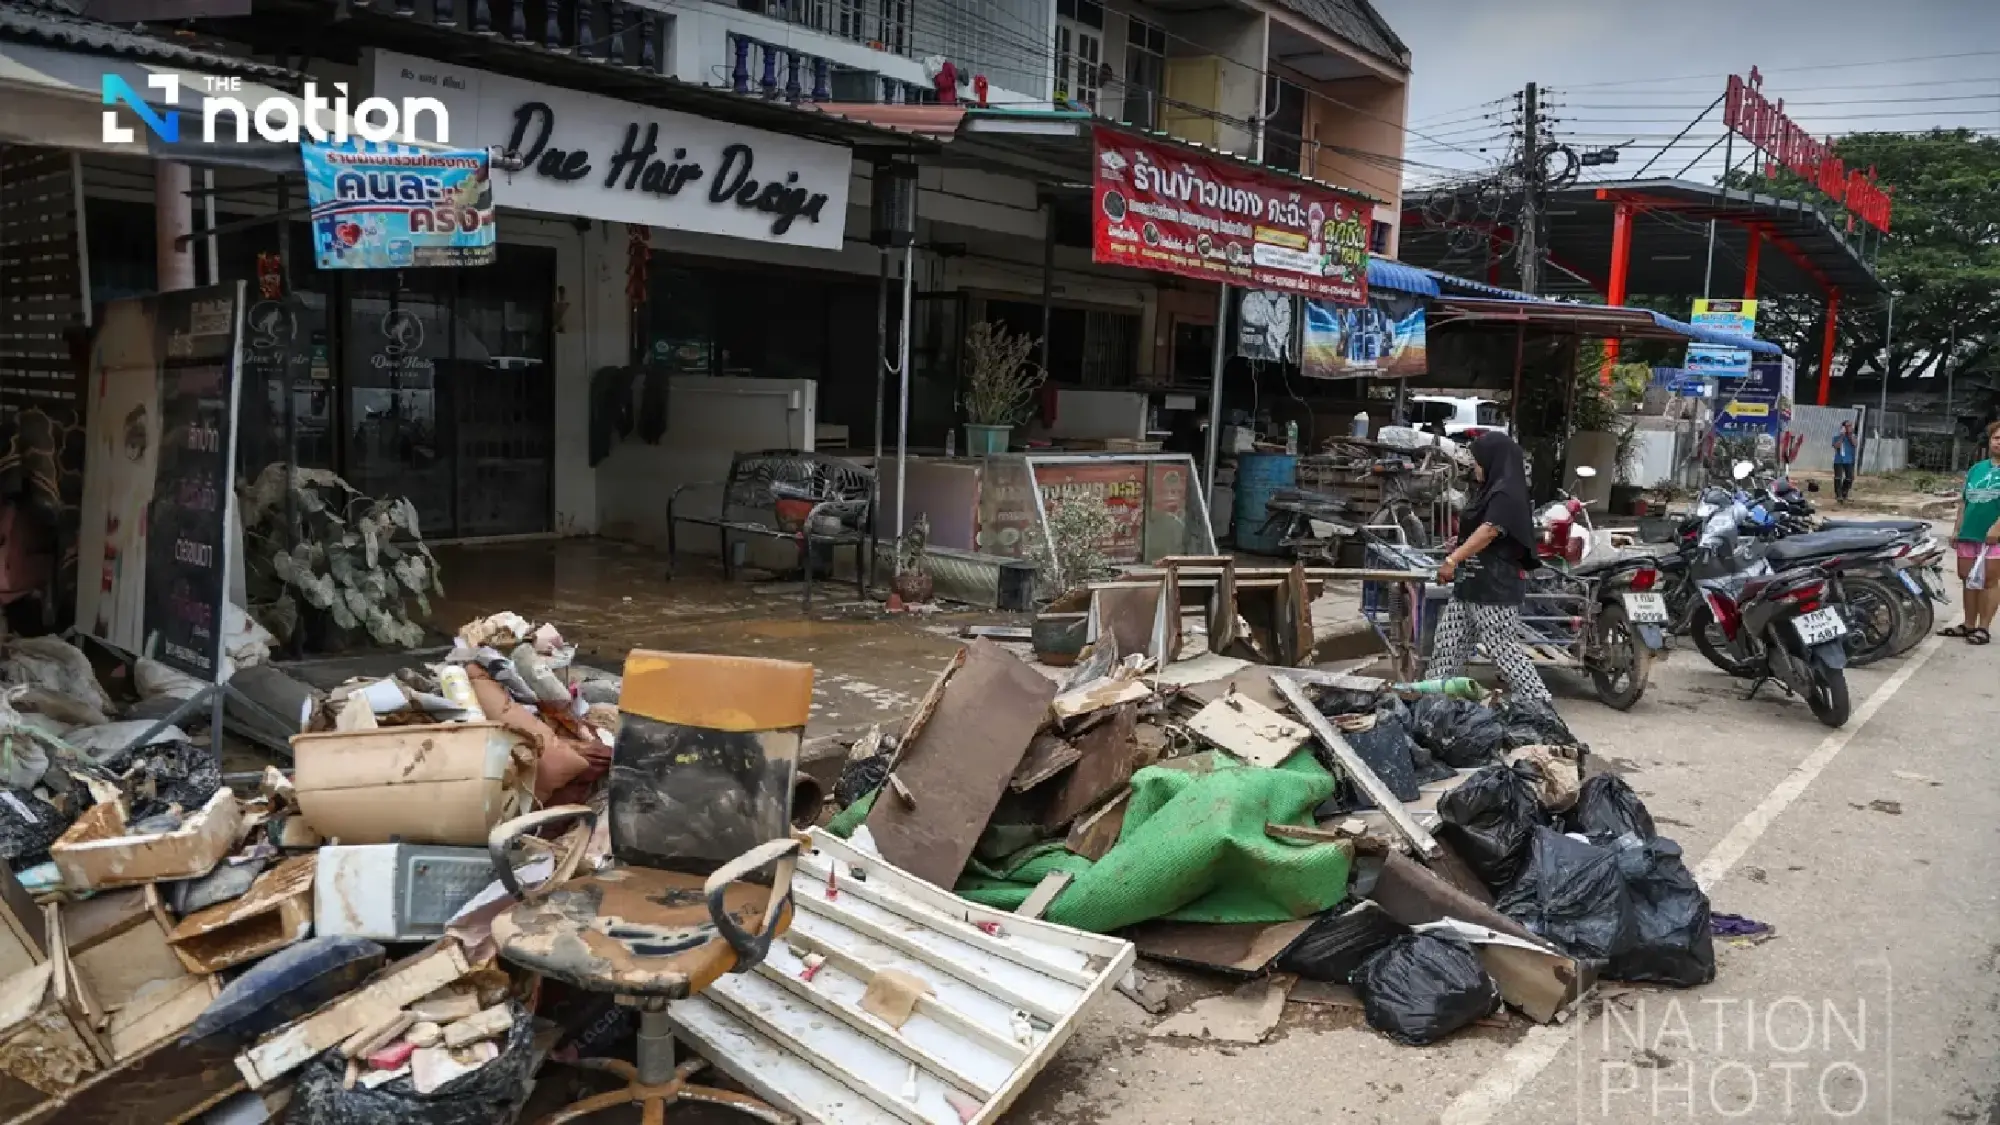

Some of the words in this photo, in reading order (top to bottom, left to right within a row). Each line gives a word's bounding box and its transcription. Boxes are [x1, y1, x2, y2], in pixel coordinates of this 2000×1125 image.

[336, 171, 442, 201] คนละ
[605, 122, 703, 194] Hair
[709, 144, 828, 235] Design
[1133, 151, 1263, 216] ร้านข้าวแกง
